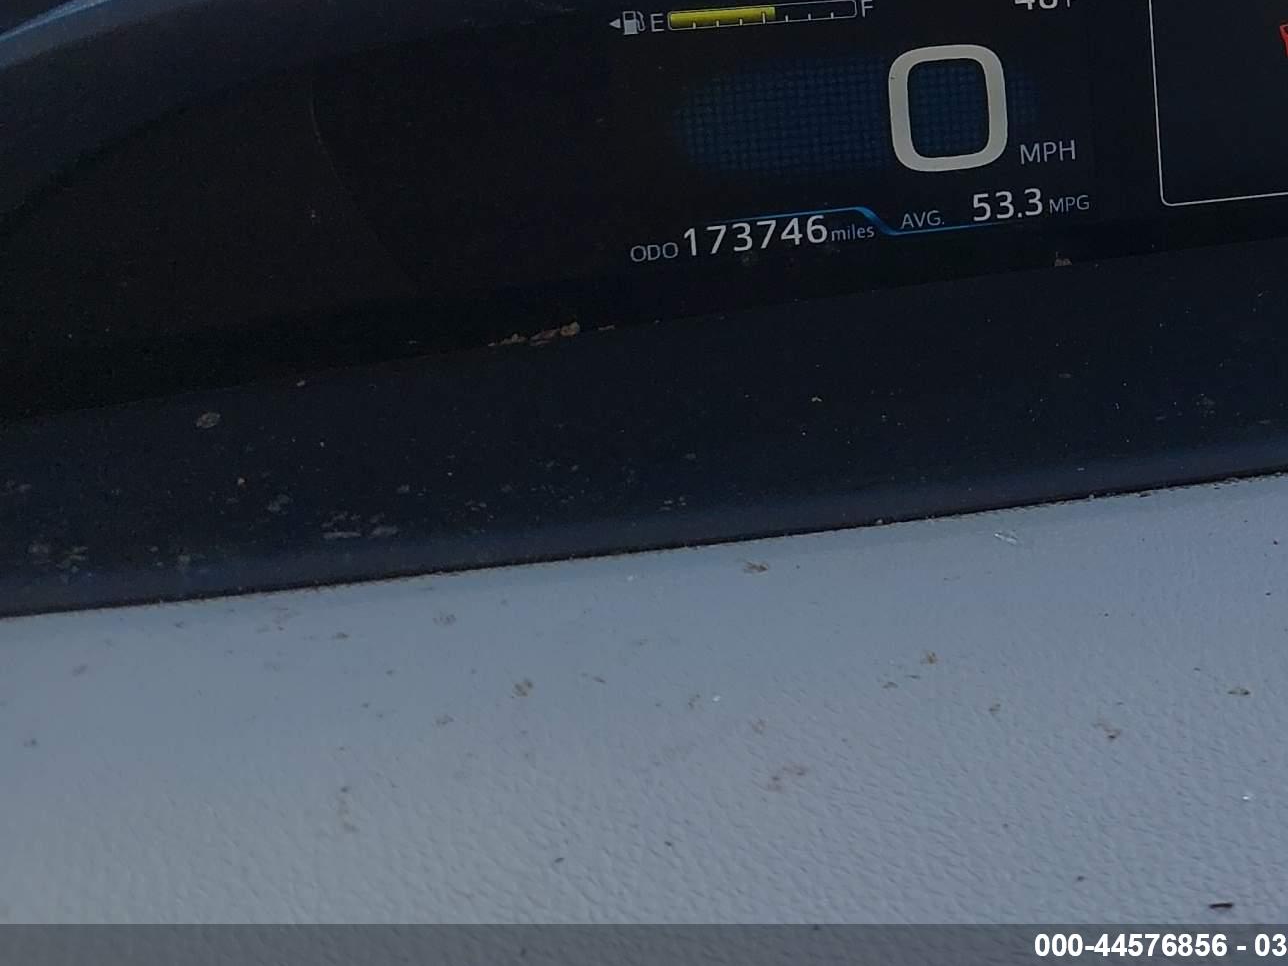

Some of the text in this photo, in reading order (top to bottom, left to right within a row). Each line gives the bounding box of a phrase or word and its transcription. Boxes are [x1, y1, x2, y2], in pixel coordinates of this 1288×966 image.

[650, 12, 665, 33] E
[887, 43, 1009, 172] 0
[1019, 139, 1077, 165] MPH
[900, 187, 1091, 230] AVG. 53.3 MPG
[630, 214, 876, 263] ODO 173746 miles
